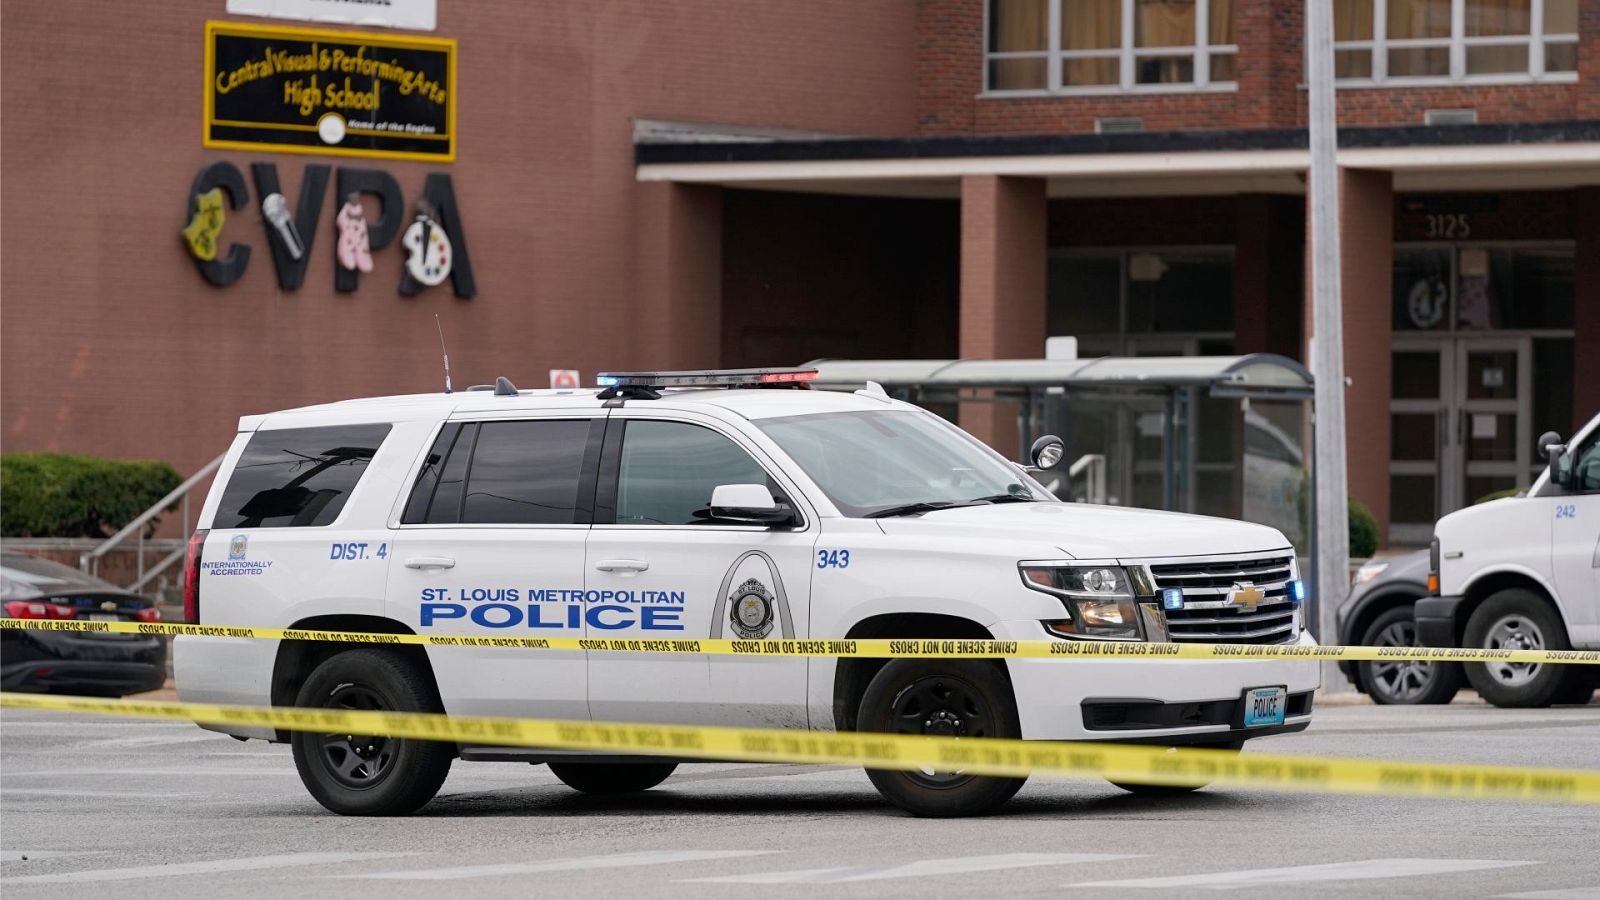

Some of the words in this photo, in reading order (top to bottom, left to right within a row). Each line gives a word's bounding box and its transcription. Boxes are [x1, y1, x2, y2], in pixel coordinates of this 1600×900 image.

[216, 46, 274, 94] Central
[272, 42, 318, 73] Visual
[332, 45, 414, 96] Performing
[412, 70, 446, 104] Arts
[284, 74, 322, 116] High
[324, 76, 380, 111] School
[186, 160, 477, 299] CVPA
[1425, 213, 1471, 238] 3125
[1556, 504, 1575, 518] 242
[330, 543, 369, 560] DIST.
[376, 543, 387, 559] 4
[202, 560, 272, 569] INTERNATIONALLY
[817, 550, 850, 568] 343
[210, 568, 262, 576] ACCREDITED
[421, 588, 451, 600] ST.
[460, 588, 520, 601] LOUIS
[528, 589, 685, 604] METROPOLITAN
[420, 603, 685, 630] POLICE
[740, 630, 764, 638] POLICE
[578, 640, 608, 650] CROSS
[609, 640, 627, 650] NOT
[628, 640, 641, 650] DO
[642, 640, 670, 652] SCENE
[672, 641, 700, 652] CRIME
[732, 641, 760, 654] CROSS
[764, 641, 780, 654] NOT
[783, 641, 794, 654] DO
[798, 641, 826, 654] SCENE
[828, 641, 856, 654] CRIME
[890, 641, 919, 654] CROSS
[922, 641, 939, 654] NOT
[942, 641, 954, 654] DO
[958, 641, 986, 654] SCENE
[988, 641, 1017, 654] CRIME
[1050, 642, 1080, 654] CROSS
[1082, 642, 1100, 654] NOT
[1103, 642, 1116, 654] DO
[1118, 642, 1148, 654] SCENE
[1150, 642, 1180, 654] CRIME
[1212, 644, 1242, 655] CROSS
[1244, 645, 1262, 656] NOT
[1266, 645, 1278, 656] DO
[1281, 646, 1310, 656] SCENE
[1313, 646, 1344, 656] CRIME
[1378, 648, 1410, 656] CROSS
[1410, 648, 1430, 656] NOT
[1432, 648, 1446, 656] DO
[1448, 649, 1478, 657] SCENE
[1480, 650, 1512, 658] CRIME
[1546, 650, 1577, 660] CROSS
[1254, 697, 1277, 718] POLICE
